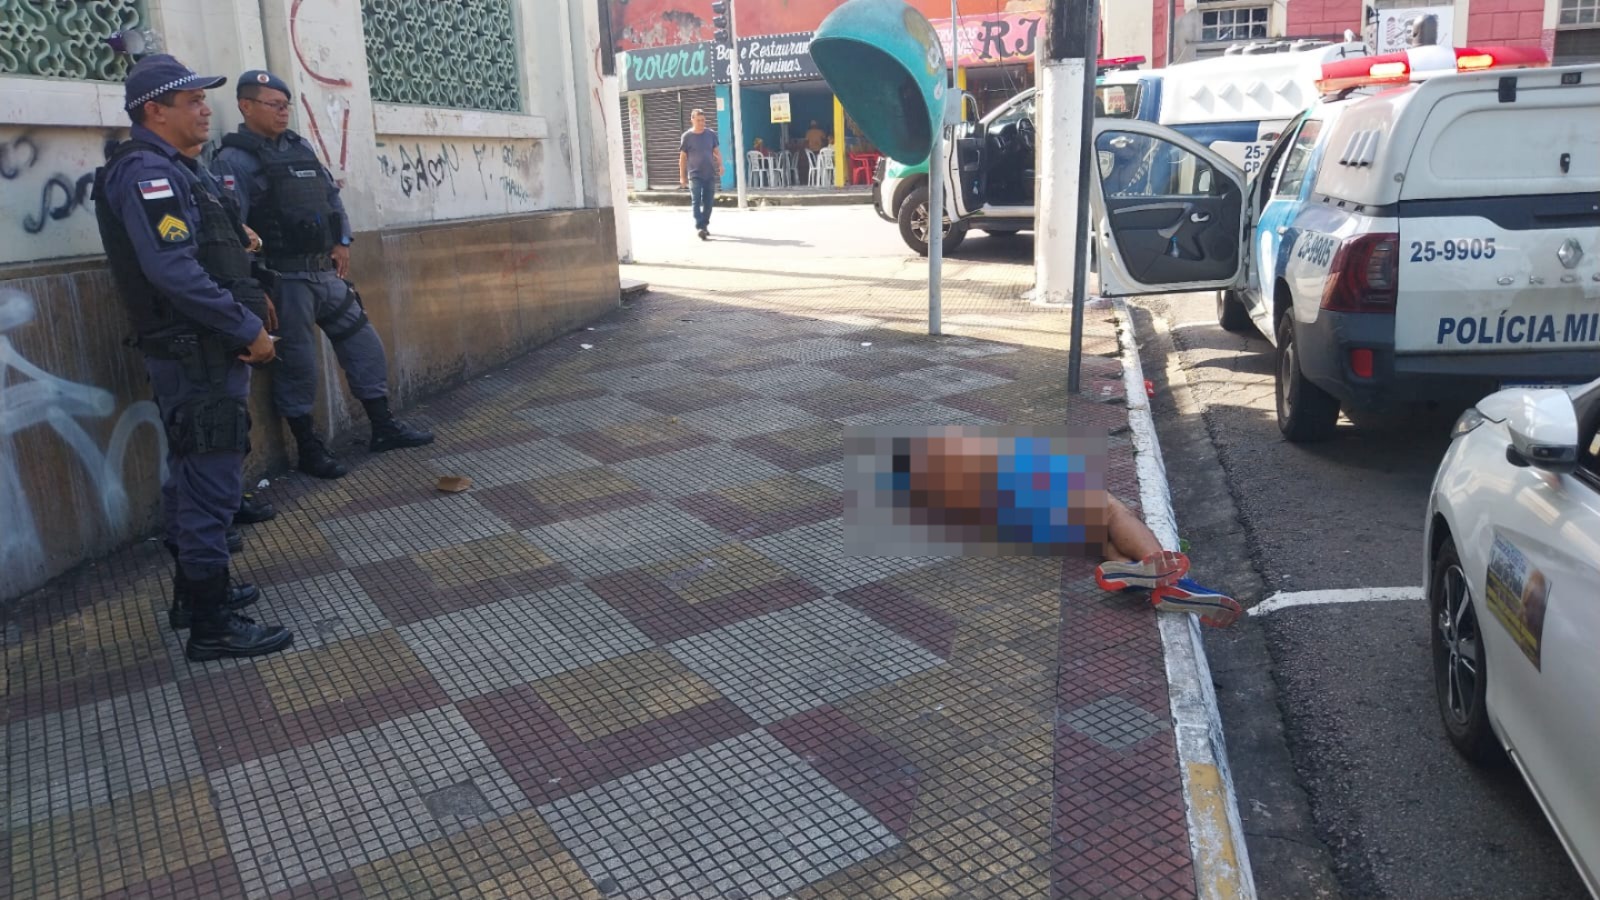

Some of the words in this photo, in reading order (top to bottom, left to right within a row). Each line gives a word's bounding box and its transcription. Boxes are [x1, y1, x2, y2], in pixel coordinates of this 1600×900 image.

[740, 47, 747, 59] e
[748, 41, 810, 59] Restauran
[750, 57, 802, 75] Meninas
[1410, 238, 1495, 262] 25-9905
[1437, 310, 1556, 344] POLÍCIA
[1563, 313, 1600, 342] MI
